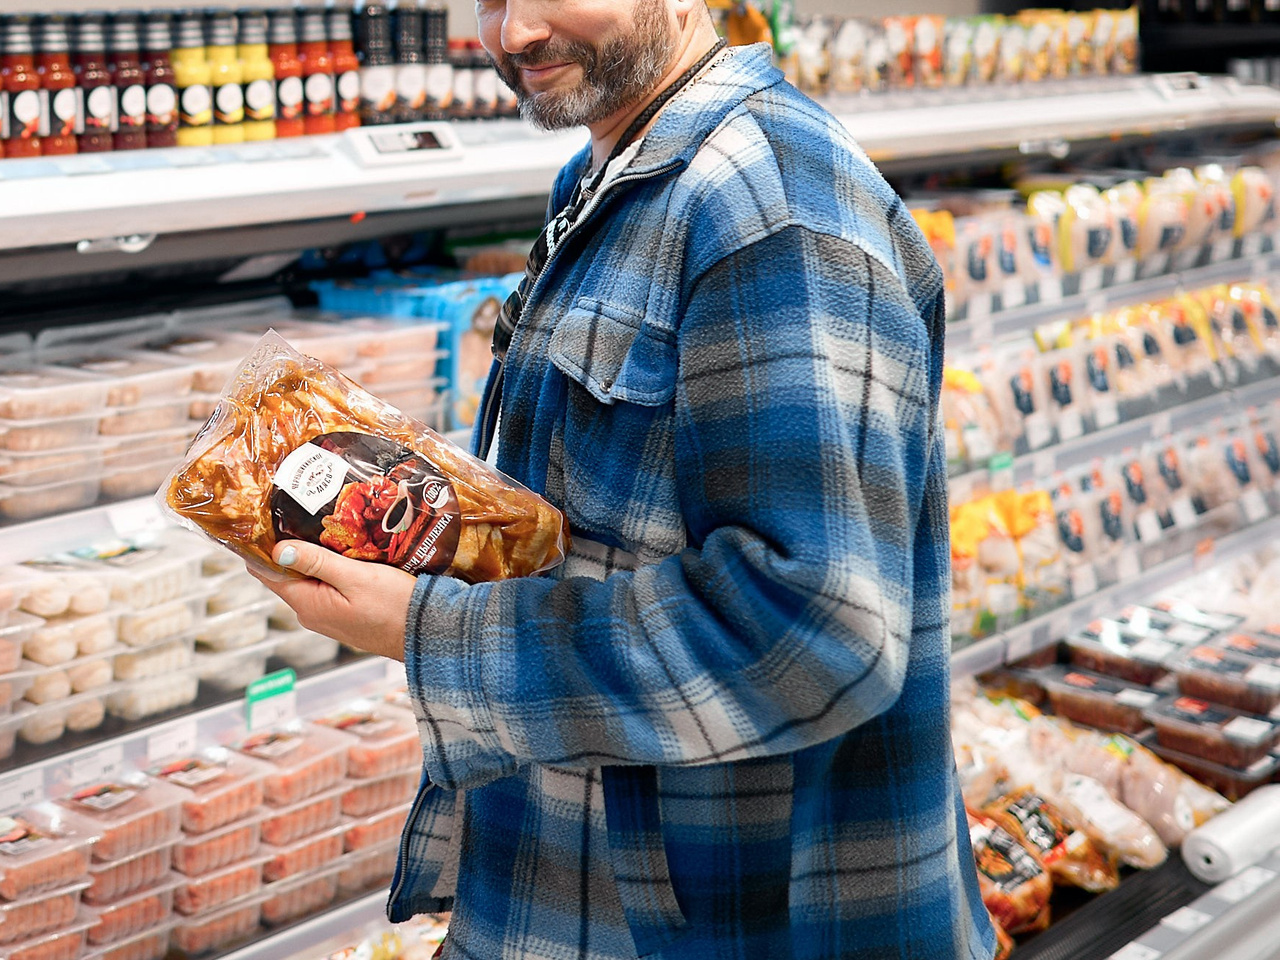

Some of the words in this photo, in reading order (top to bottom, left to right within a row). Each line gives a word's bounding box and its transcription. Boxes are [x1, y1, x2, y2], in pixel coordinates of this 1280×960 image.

[316, 473, 333, 494] МЯСО
[425, 482, 442, 502] 100%
[415, 513, 454, 560] ЦЫПЛЕНКА
